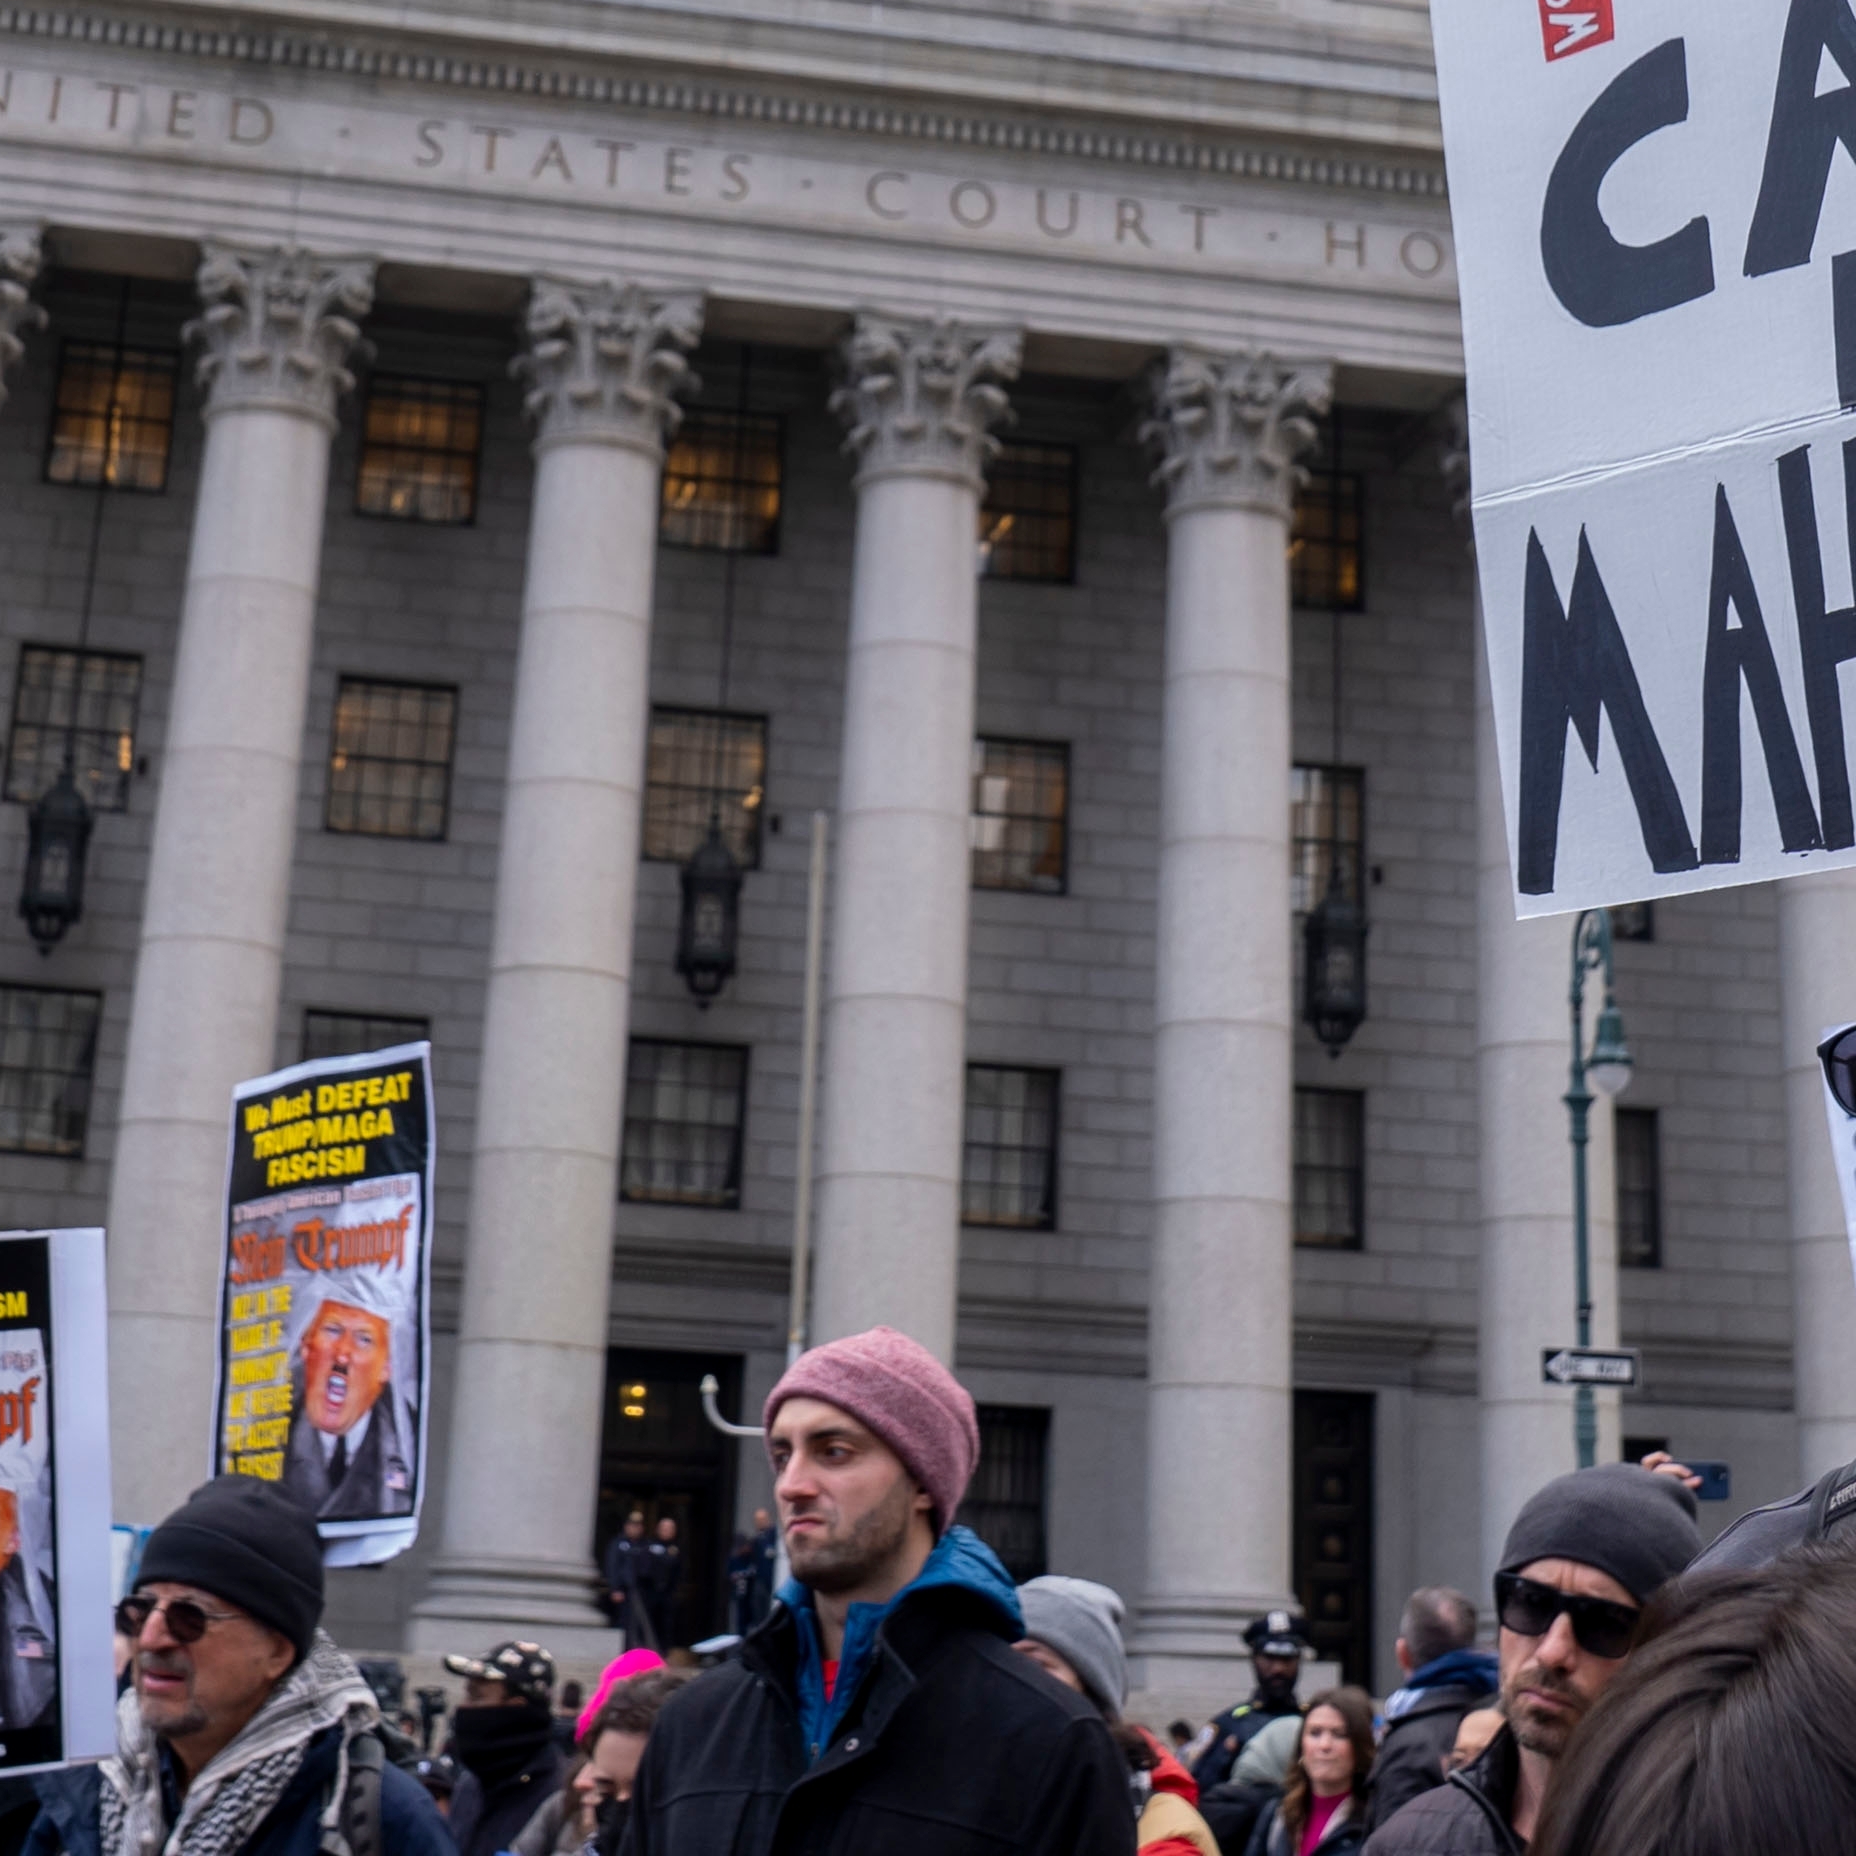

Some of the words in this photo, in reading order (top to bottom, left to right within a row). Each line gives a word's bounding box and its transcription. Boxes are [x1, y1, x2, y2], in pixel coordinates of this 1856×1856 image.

[415, 119, 752, 201] STATES
[865, 168, 1221, 252] COURT
[1325, 220, 1445, 280] HO
[316, 1072, 413, 1113] DEFEAT
[253, 1109, 395, 1159] TRUMP/MAGA
[267, 1145, 366, 1187] FASCISM
